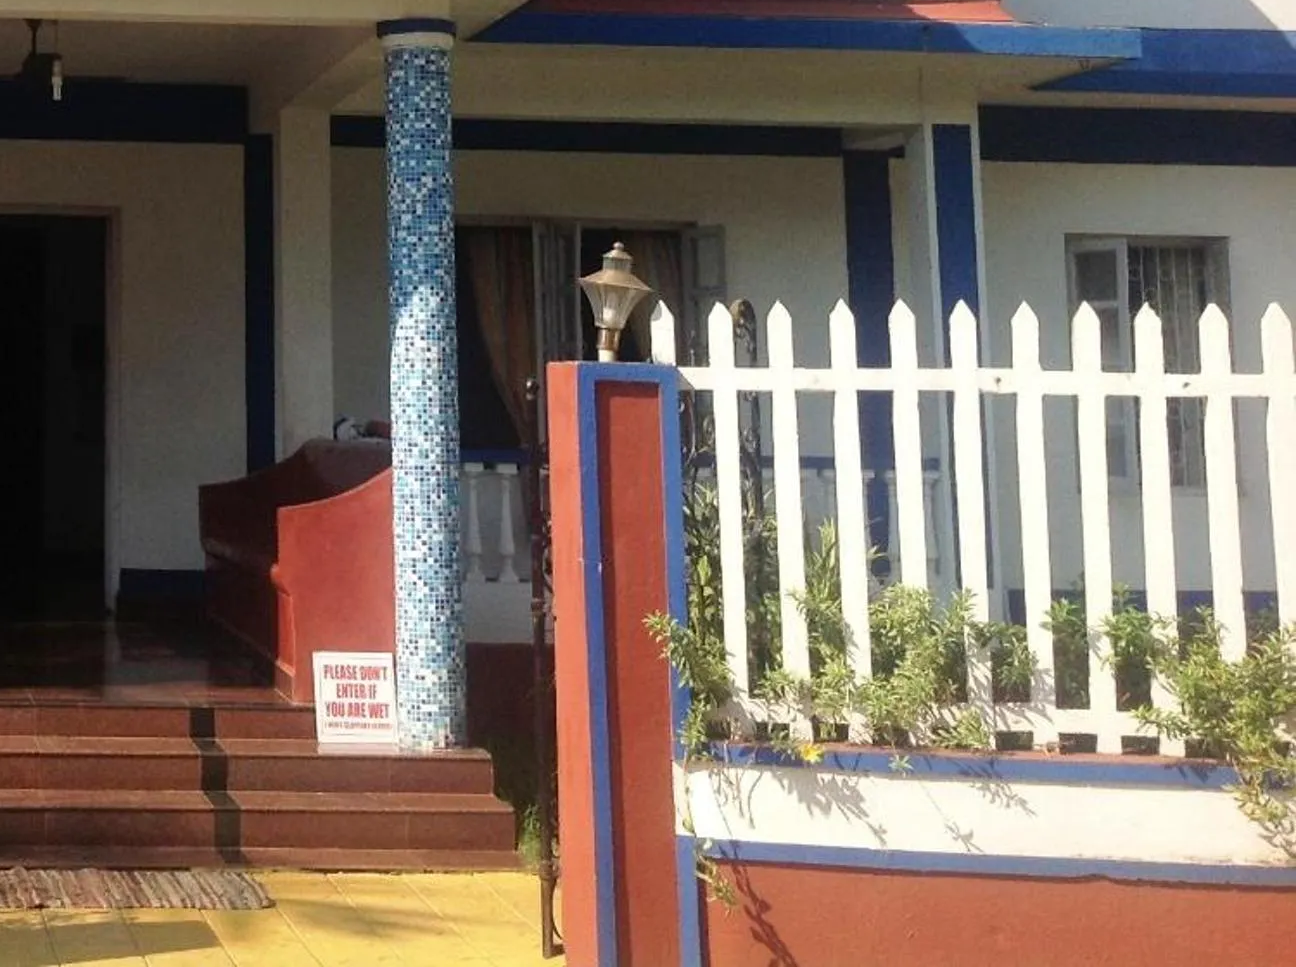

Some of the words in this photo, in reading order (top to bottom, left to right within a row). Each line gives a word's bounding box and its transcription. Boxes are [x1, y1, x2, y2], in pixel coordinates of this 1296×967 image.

[323, 664, 357, 680] PLEASE
[336, 683, 366, 699] ENTER
[368, 684, 377, 699] IF
[325, 702, 345, 717] YOU
[347, 703, 366, 718] ARE
[368, 703, 390, 719] WET
